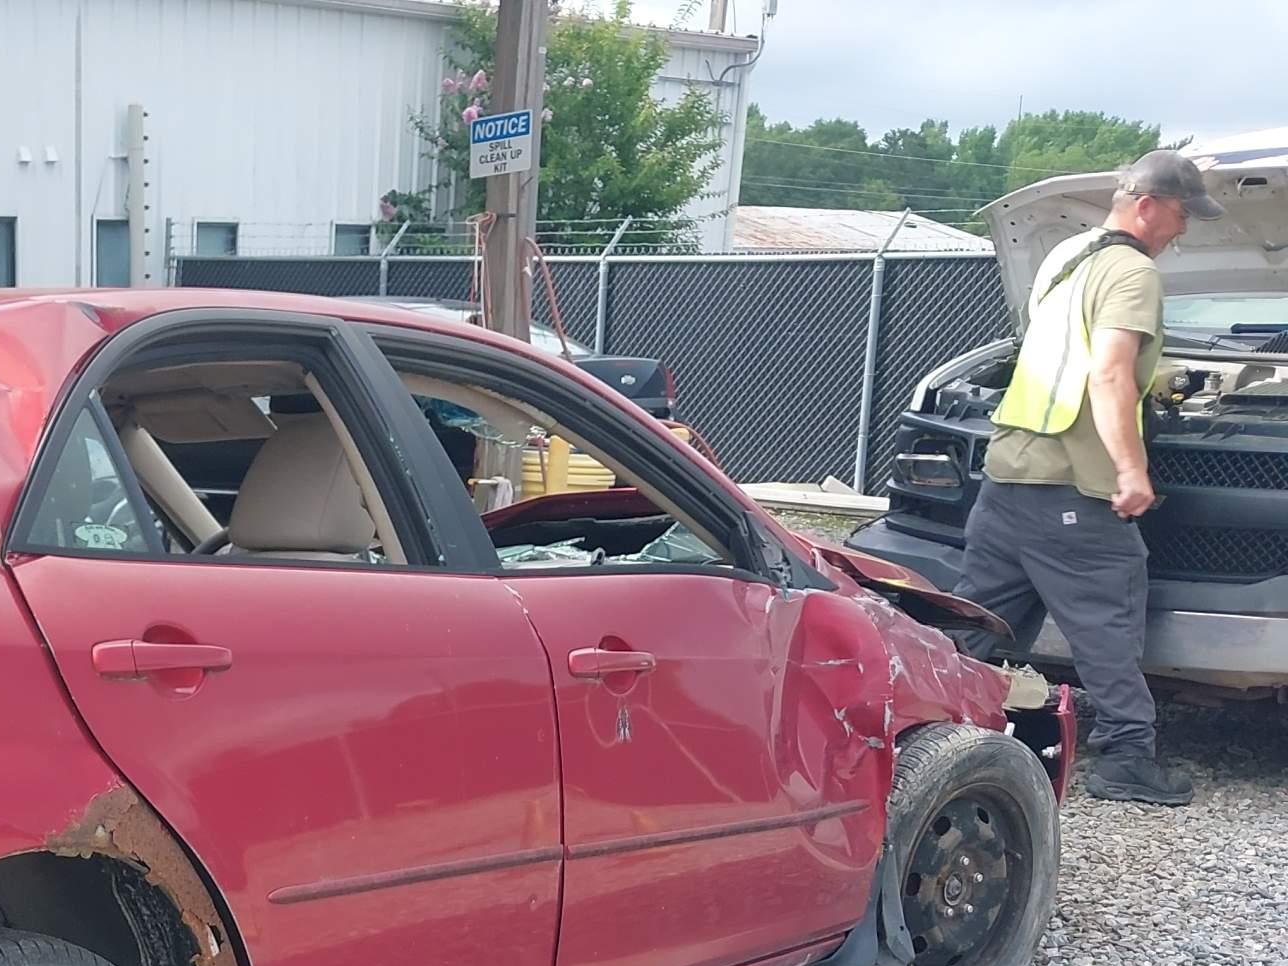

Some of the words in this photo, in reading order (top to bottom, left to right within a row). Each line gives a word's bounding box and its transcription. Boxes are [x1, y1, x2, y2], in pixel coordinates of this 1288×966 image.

[475, 115, 528, 140] NOTICE
[489, 139, 512, 151] SPILL
[479, 152, 507, 164] CLEAN
[511, 149, 522, 159] UP
[494, 163, 508, 173] KIT
